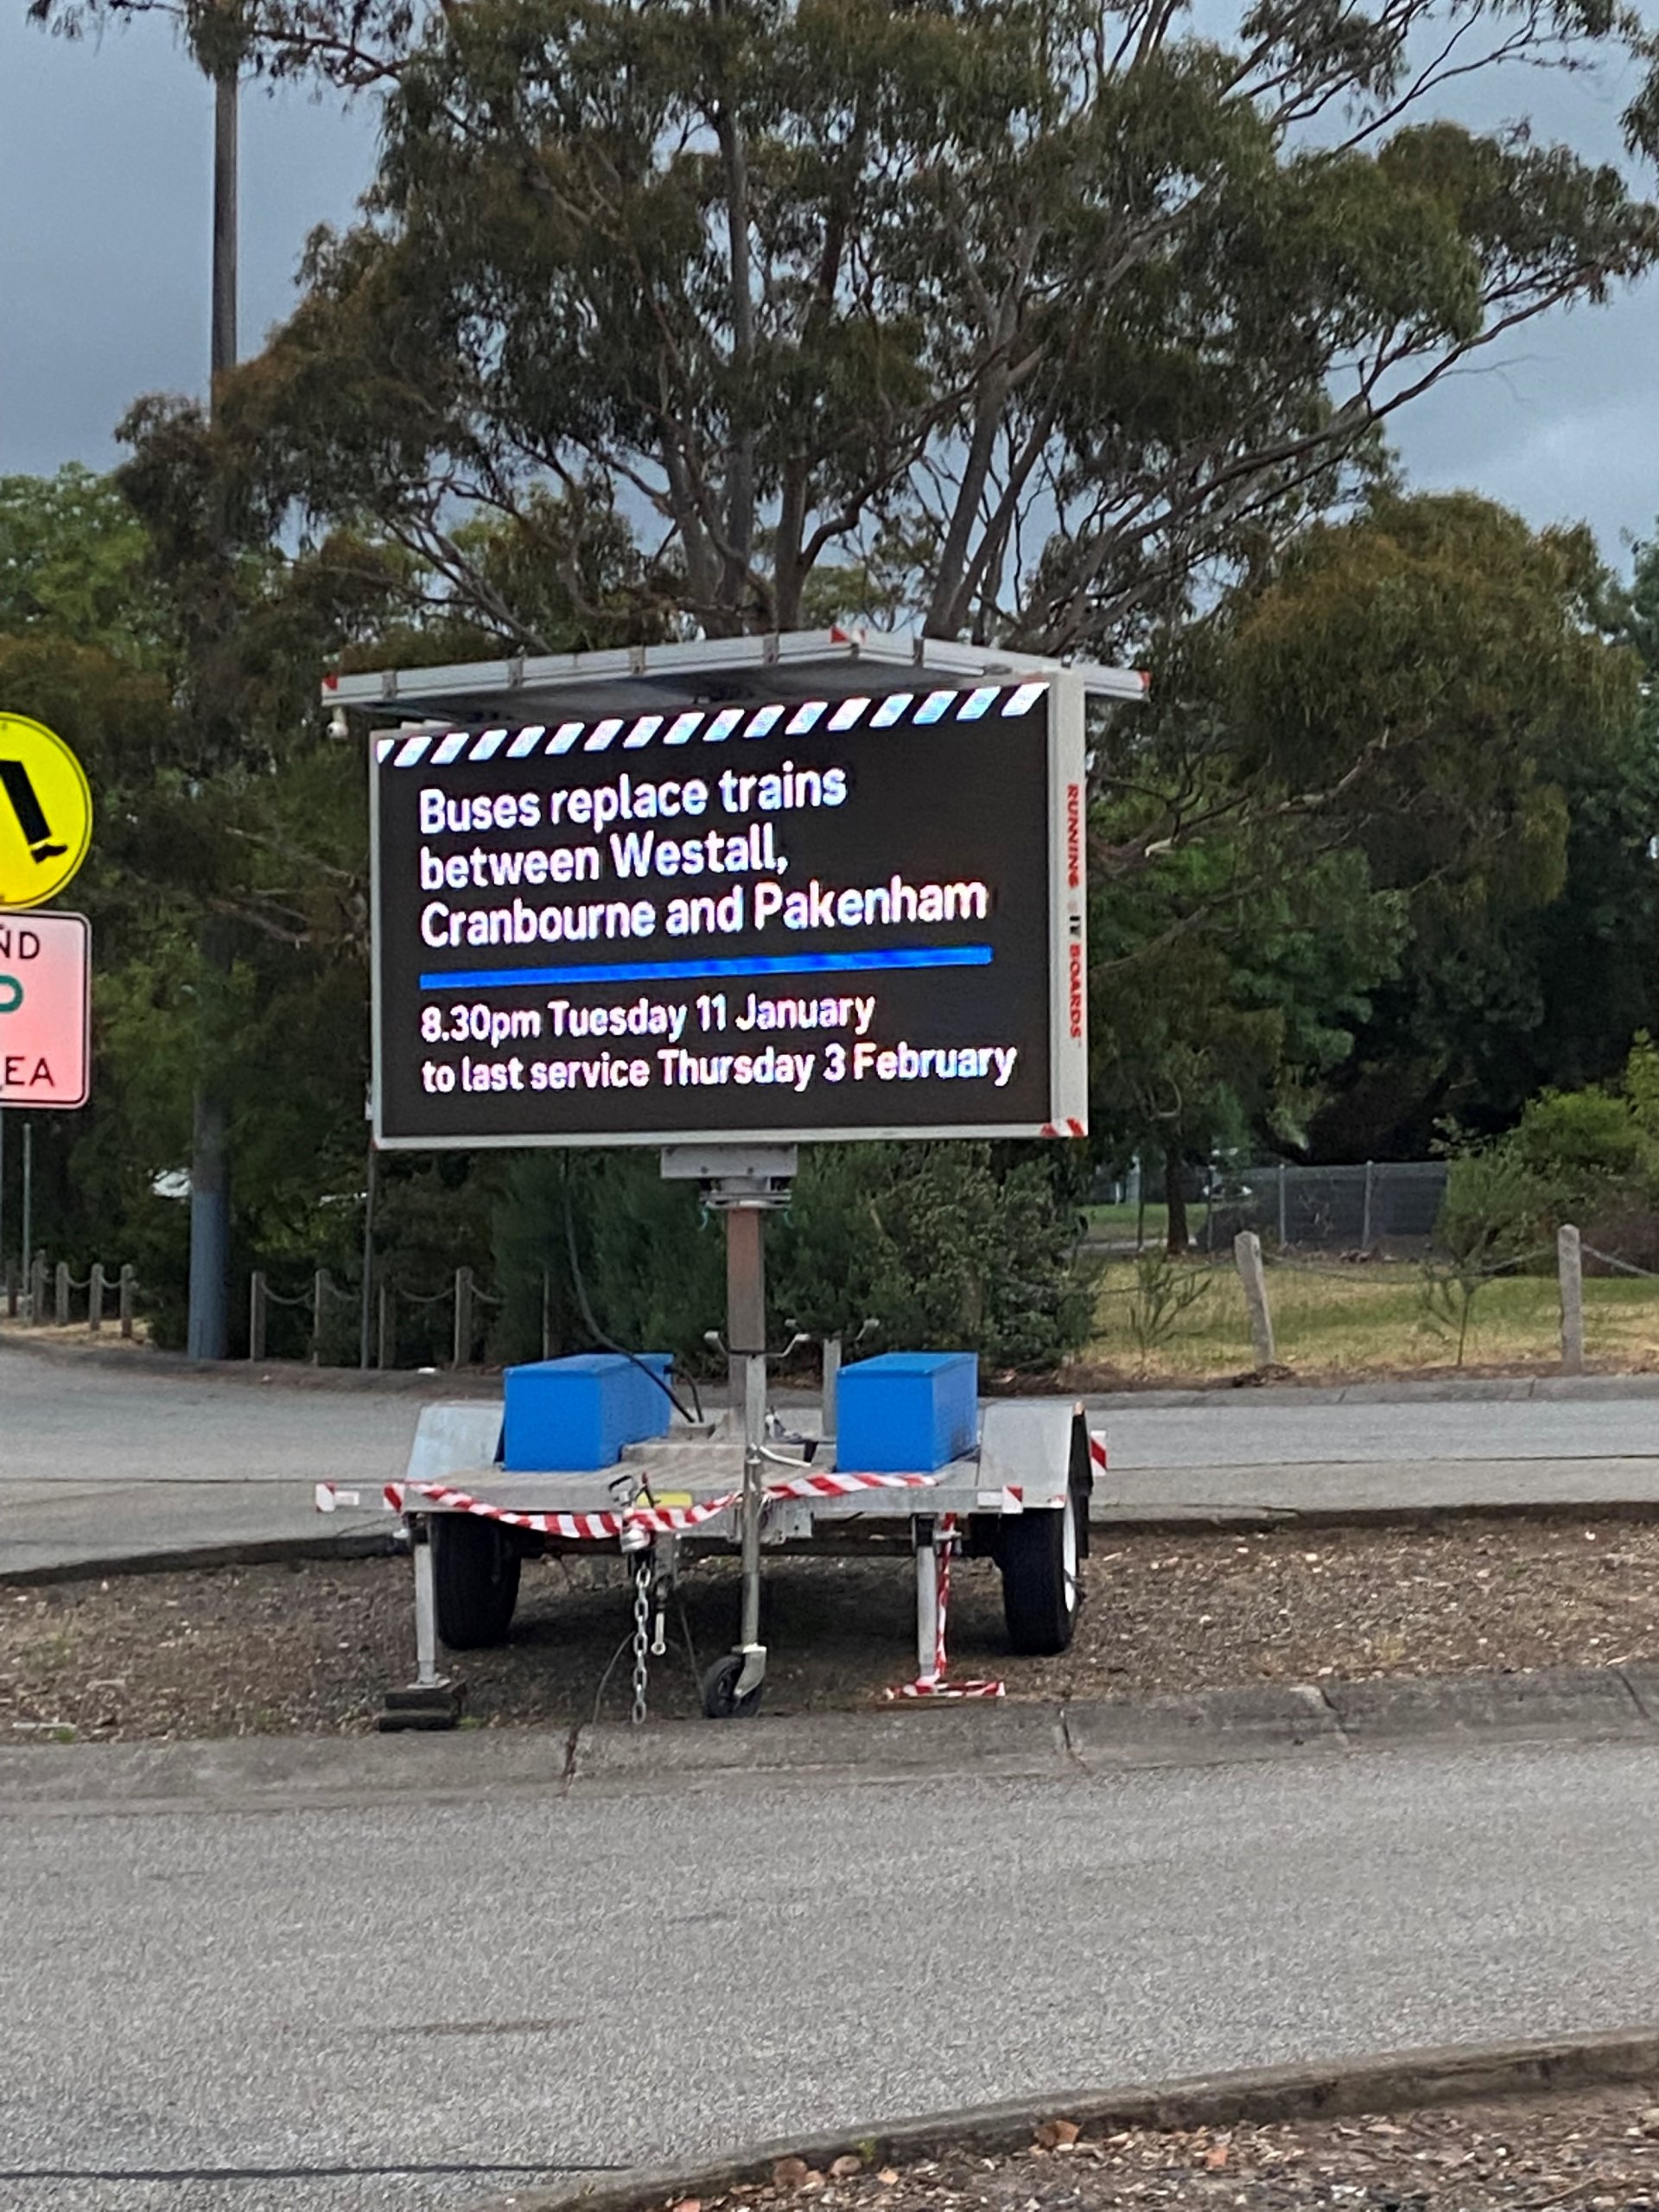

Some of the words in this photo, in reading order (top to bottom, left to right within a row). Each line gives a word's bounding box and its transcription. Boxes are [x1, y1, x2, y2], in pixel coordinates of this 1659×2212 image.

[420, 789, 542, 835] Buses
[551, 773, 709, 834] replace
[718, 760, 847, 813] trains
[420, 846, 601, 891] between
[609, 822, 789, 878] Westall,
[420, 898, 657, 948] Cranbourne
[665, 885, 744, 937] and
[753, 874, 990, 931] Pakenham
[420, 1004, 542, 1048] 8.30pm
[547, 997, 688, 1043] Tuesday
[696, 993, 727, 1032] 11
[734, 992, 876, 1035] January
[1069, 944, 1082, 1039] BOARDS
[5, 1056, 54, 1087] EA
[421, 1058, 456, 1092] to
[461, 1056, 524, 1092] last
[530, 1051, 651, 1090] service
[657, 1045, 817, 1092] Thursday
[823, 1042, 849, 1083] 3
[853, 1040, 1018, 1087] February
